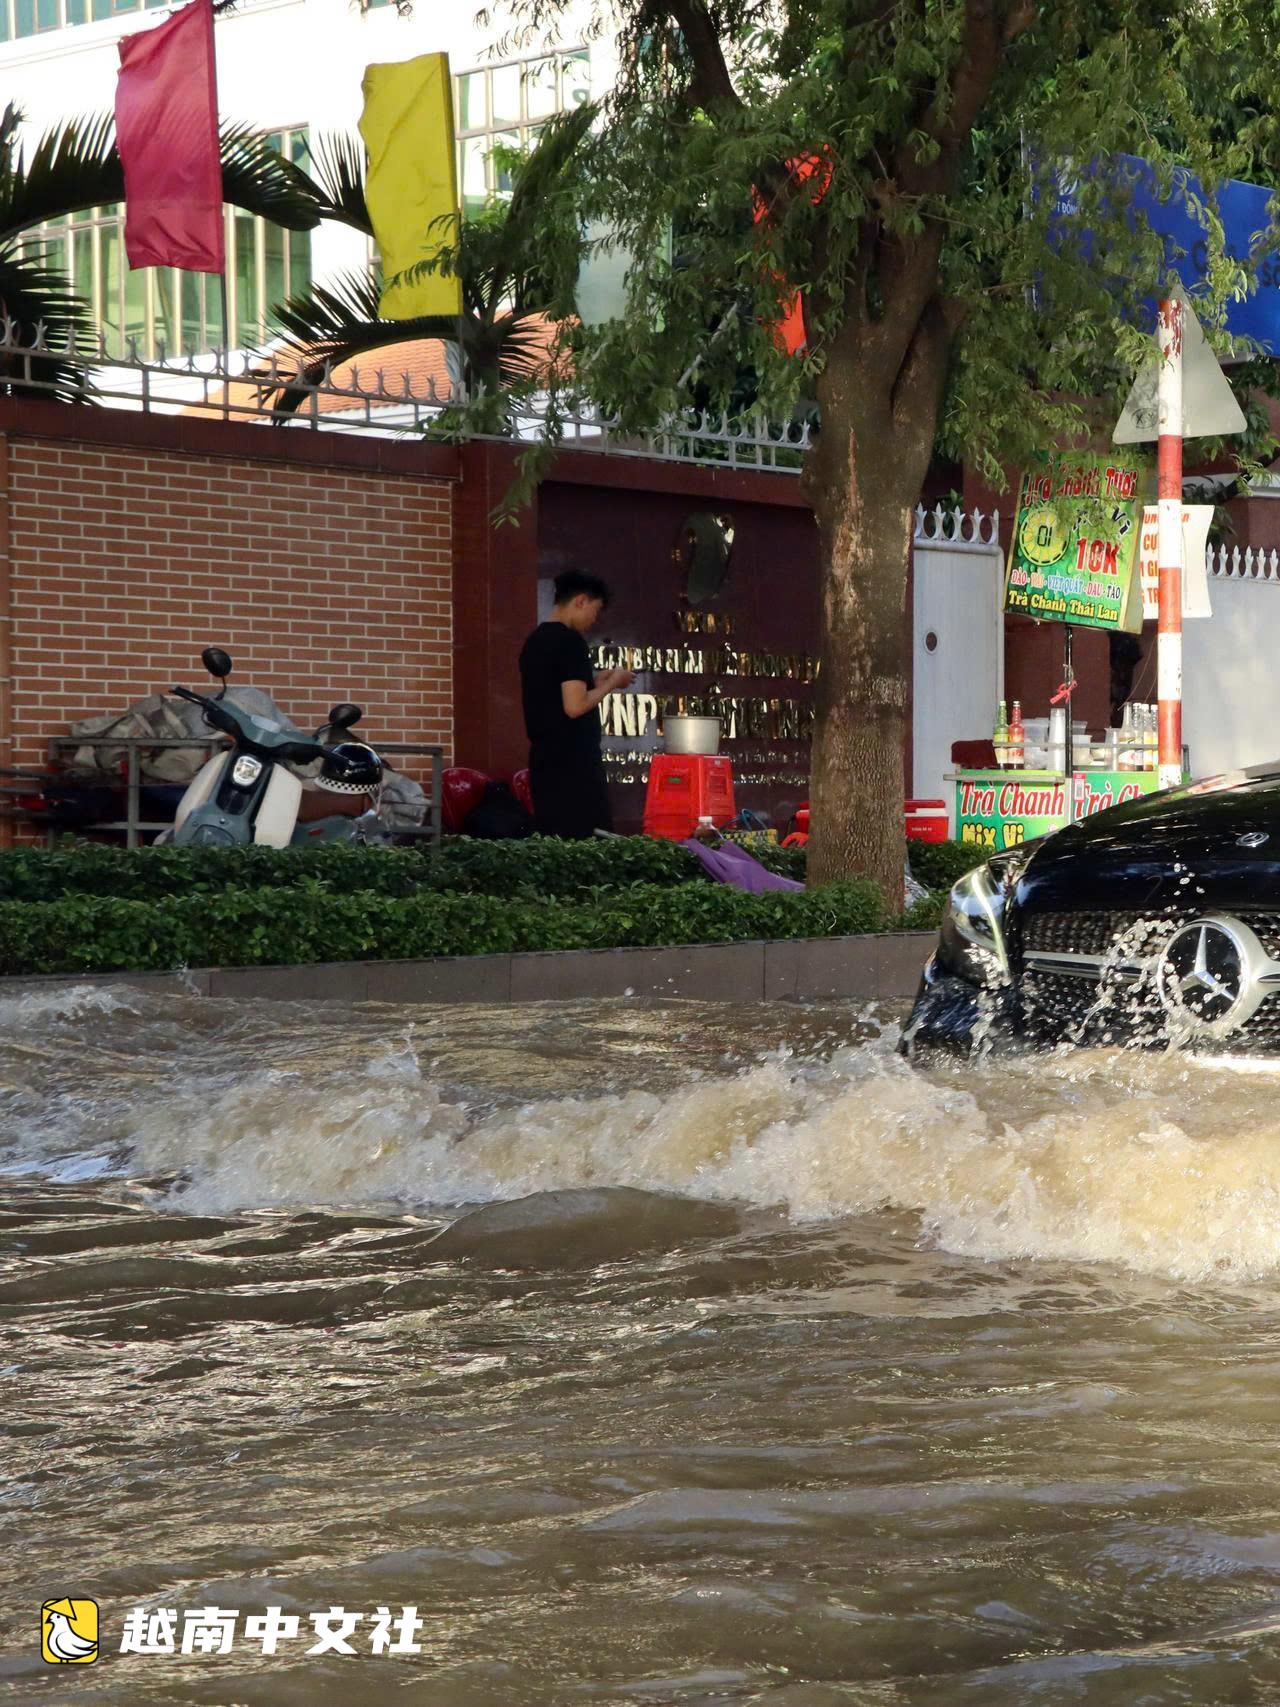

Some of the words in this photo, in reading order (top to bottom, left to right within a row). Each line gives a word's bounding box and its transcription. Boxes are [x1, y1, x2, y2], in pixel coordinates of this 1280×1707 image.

[1076, 536, 1121, 576] 10K
[1009, 590, 1028, 605] Trà
[1030, 593, 1066, 613] Chanh
[1069, 599, 1095, 618] Thái
[1097, 604, 1119, 622] Lan
[960, 781, 995, 817] Trà
[999, 782, 1065, 817] Chanh
